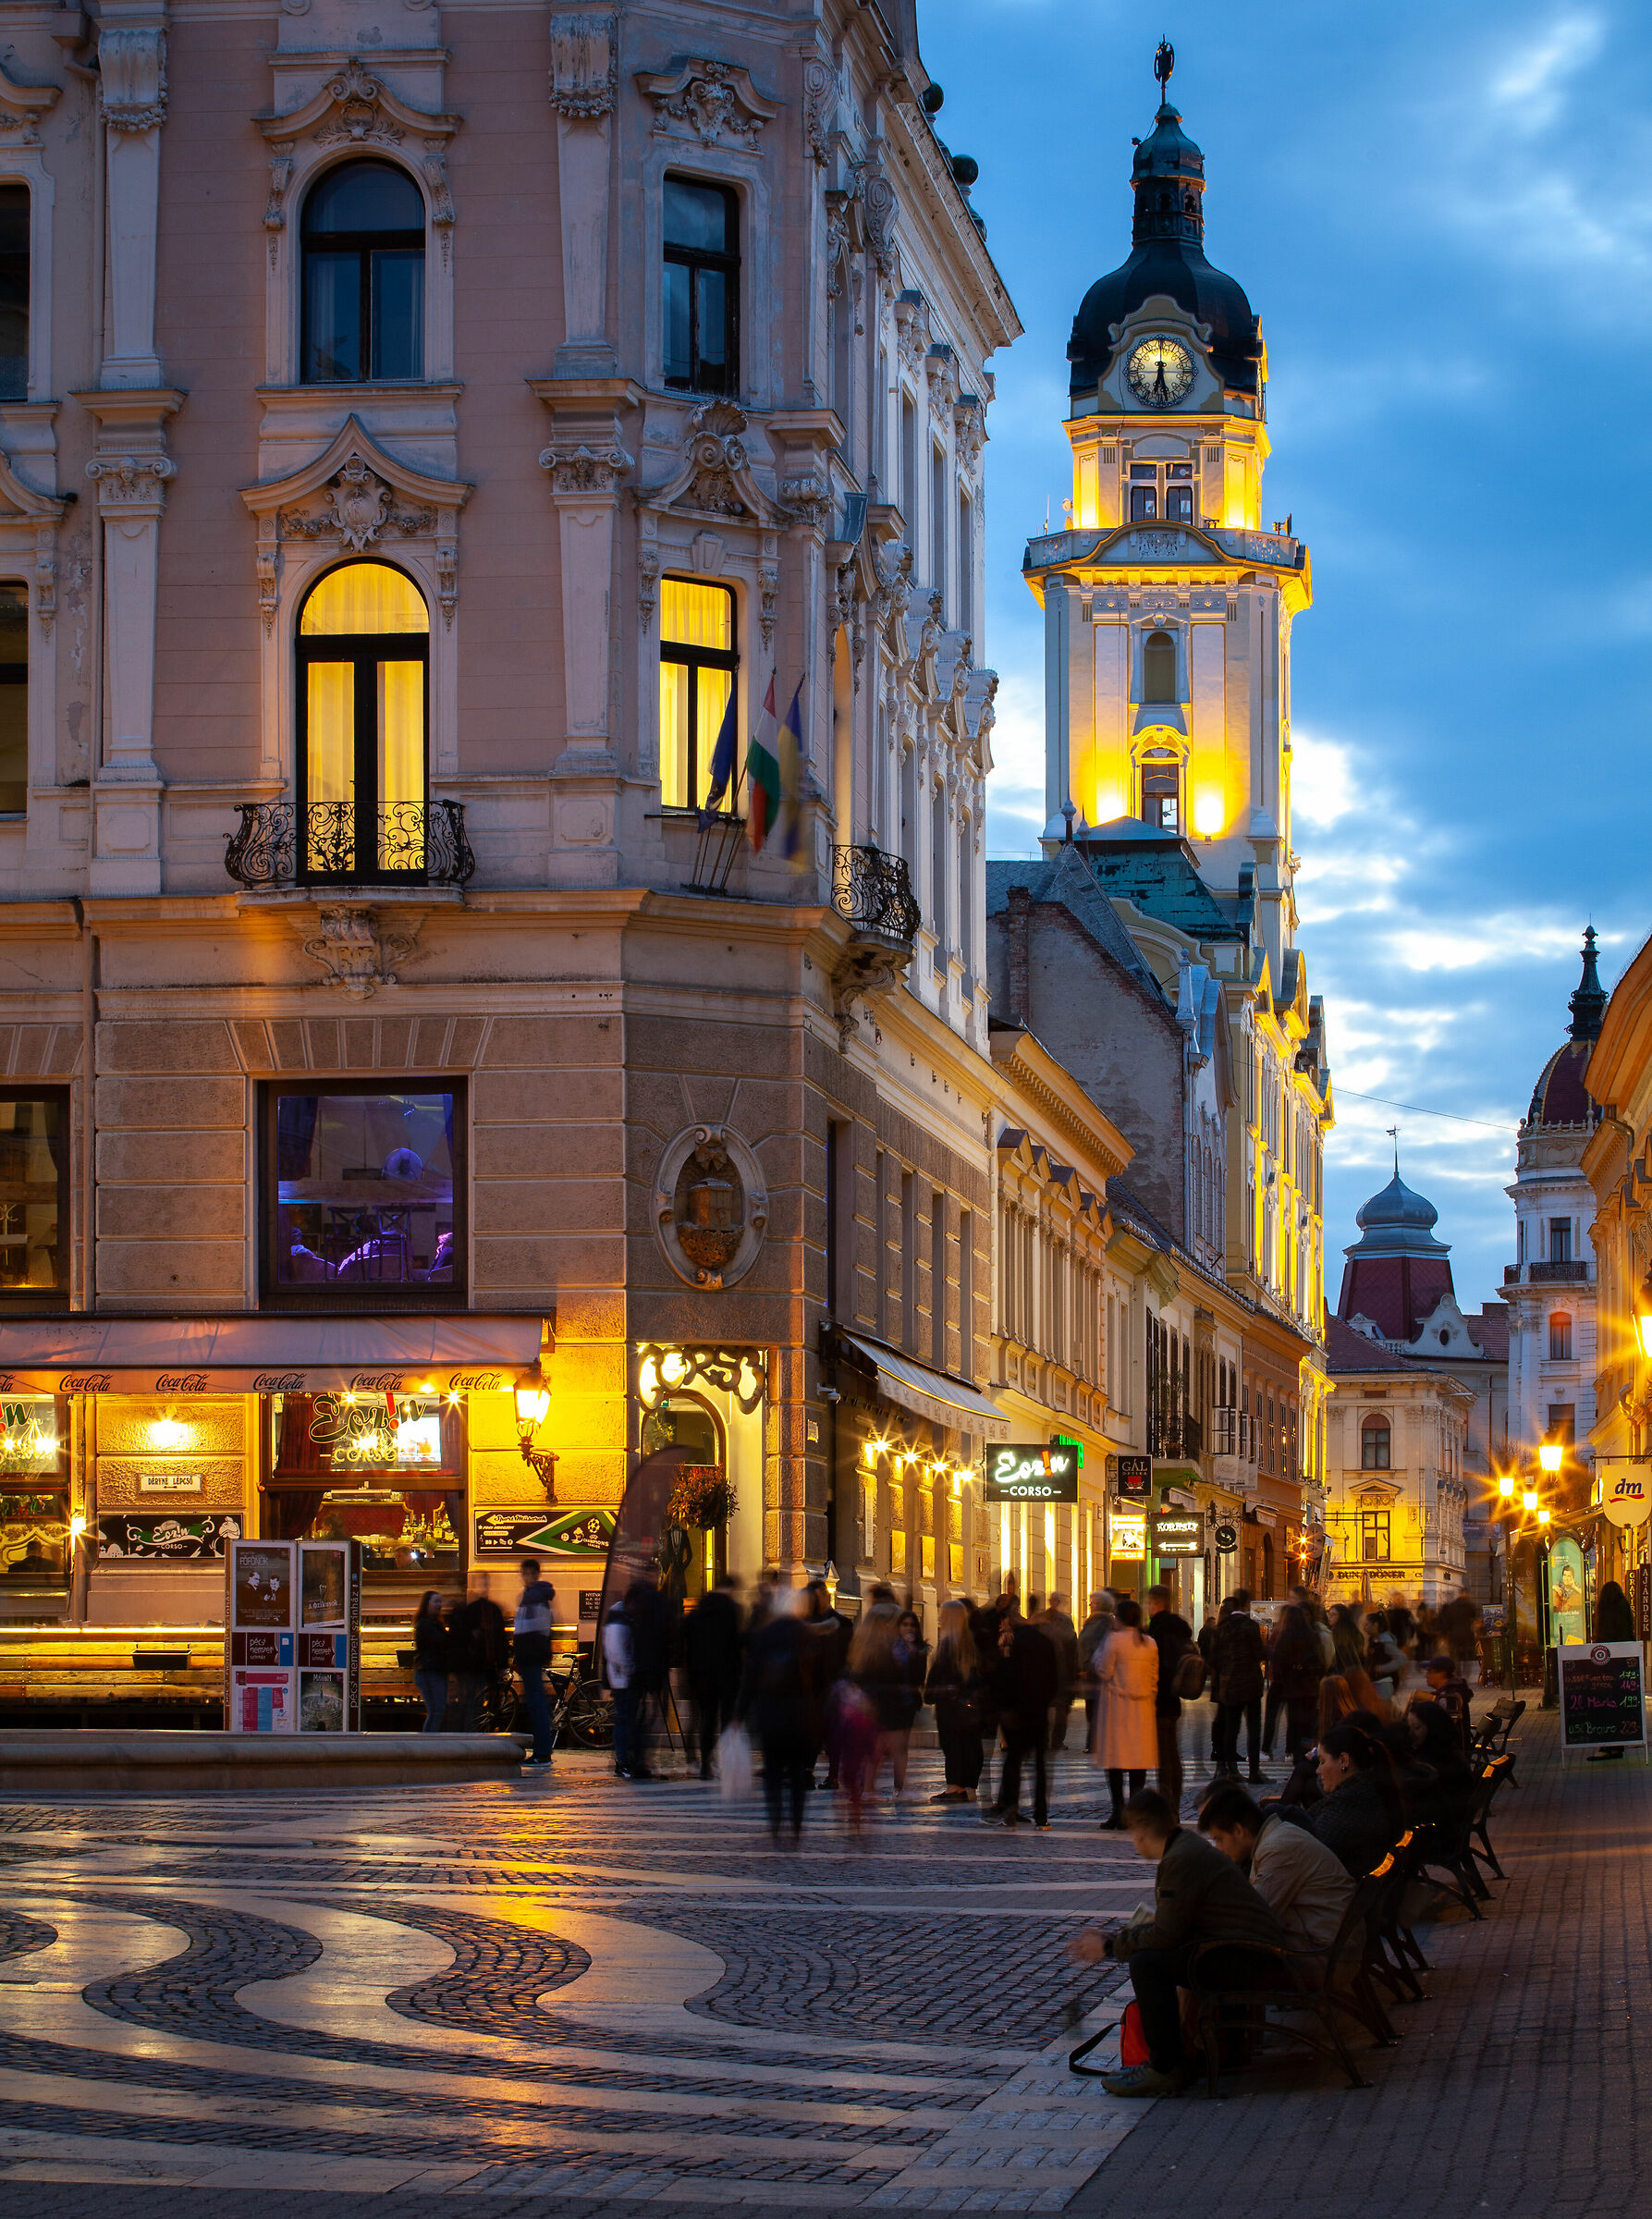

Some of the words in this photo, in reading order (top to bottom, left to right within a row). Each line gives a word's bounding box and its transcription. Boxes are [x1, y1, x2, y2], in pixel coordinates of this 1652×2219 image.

[1121, 1458, 1147, 1472] GÁL
[1010, 1485, 1052, 1497] CORSO
[1615, 1478, 1642, 1494] dm
[1369, 1569, 1405, 1578] DÖNER
